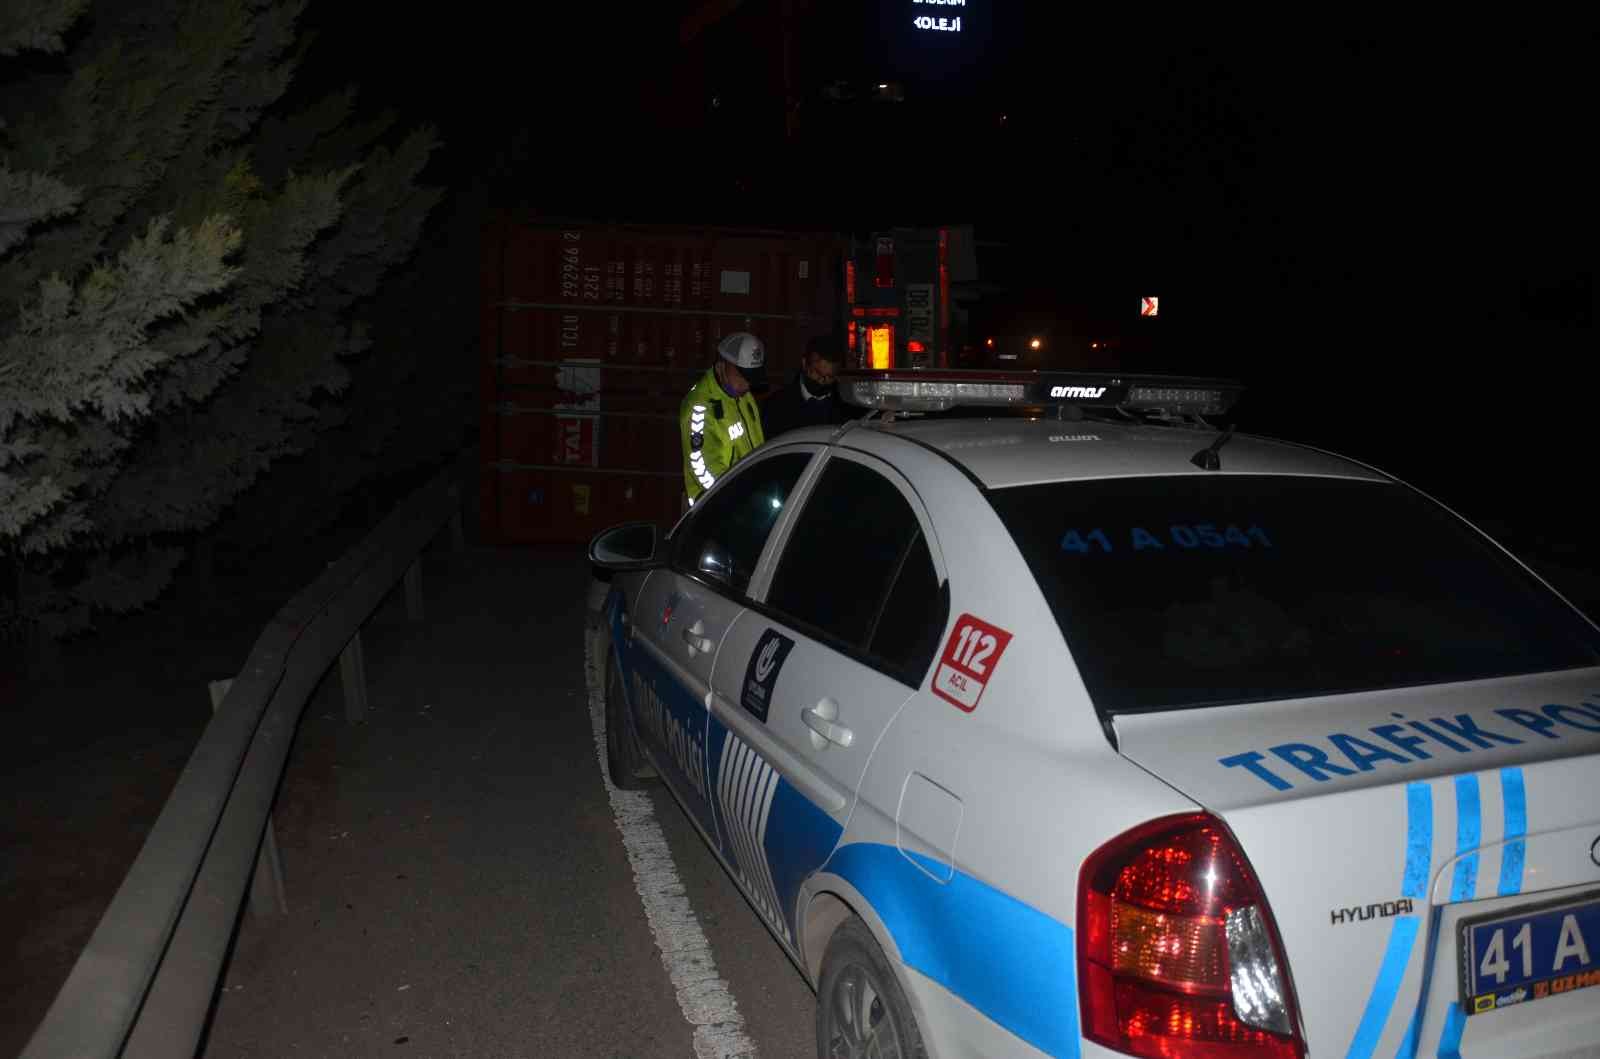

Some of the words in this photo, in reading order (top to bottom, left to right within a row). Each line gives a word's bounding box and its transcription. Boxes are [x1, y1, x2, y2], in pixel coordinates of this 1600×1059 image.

[561, 231, 581, 242] 2
[561, 247, 579, 297] 292966
[583, 263, 600, 299] 22G1
[561, 314, 579, 349] TCLU
[1050, 386, 1107, 398] armas
[1061, 528, 1112, 553] 41
[1131, 528, 1164, 551] A
[1169, 523, 1273, 550] 0541
[952, 625, 997, 675] 112
[1220, 711, 1523, 791] TRAFİK
[1330, 899, 1413, 925] HYUNDAI
[1480, 922, 1532, 983] 41
[1552, 914, 1591, 971] A
